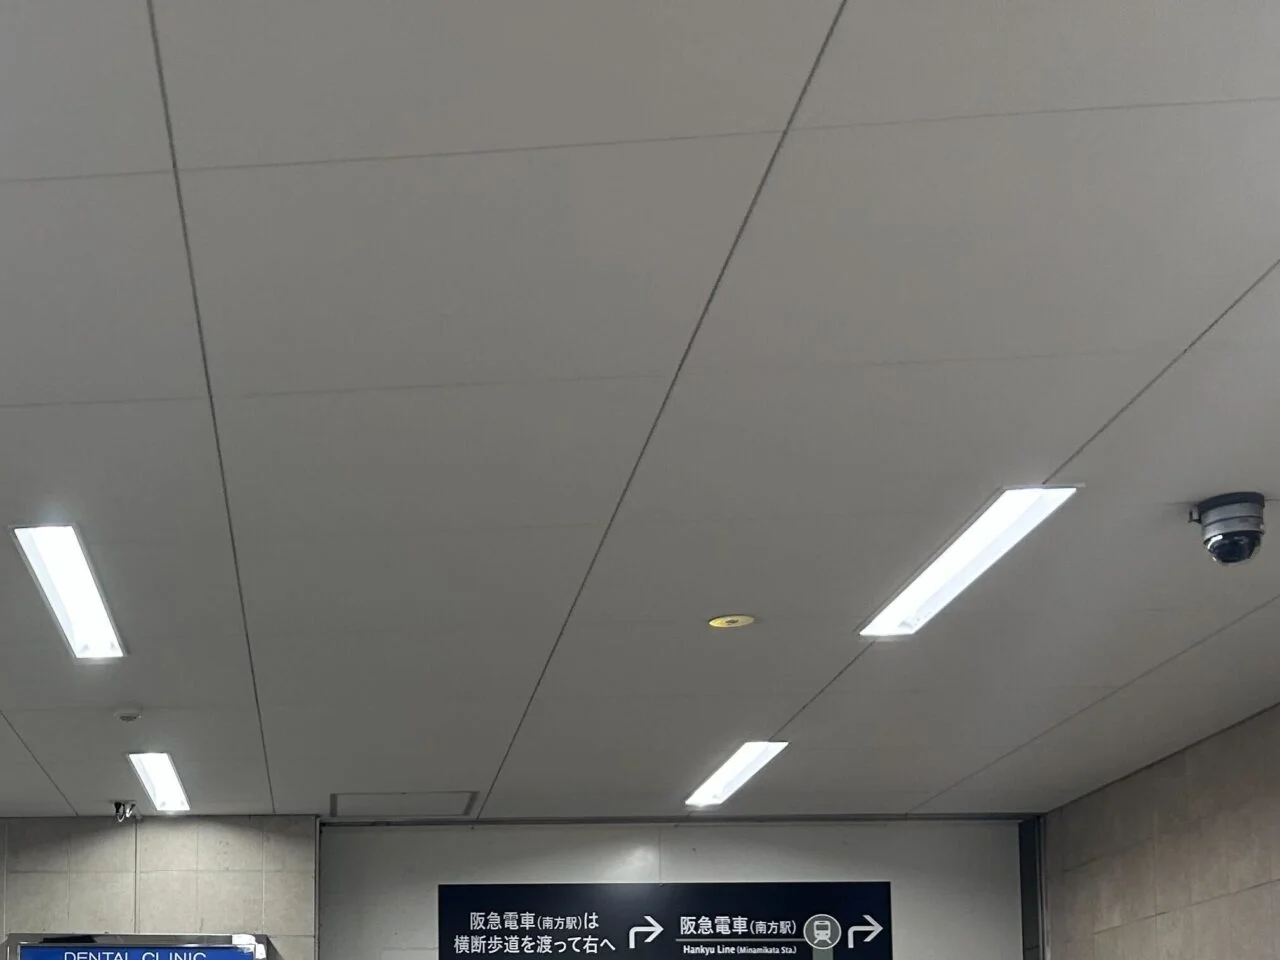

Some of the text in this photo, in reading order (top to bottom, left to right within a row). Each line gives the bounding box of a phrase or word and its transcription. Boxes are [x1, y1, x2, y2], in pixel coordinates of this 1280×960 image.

[453, 935, 616, 955] 横断歩道を渡って右へ
[683, 945, 715, 957] Hankyu
[717, 945, 735, 956] Line
